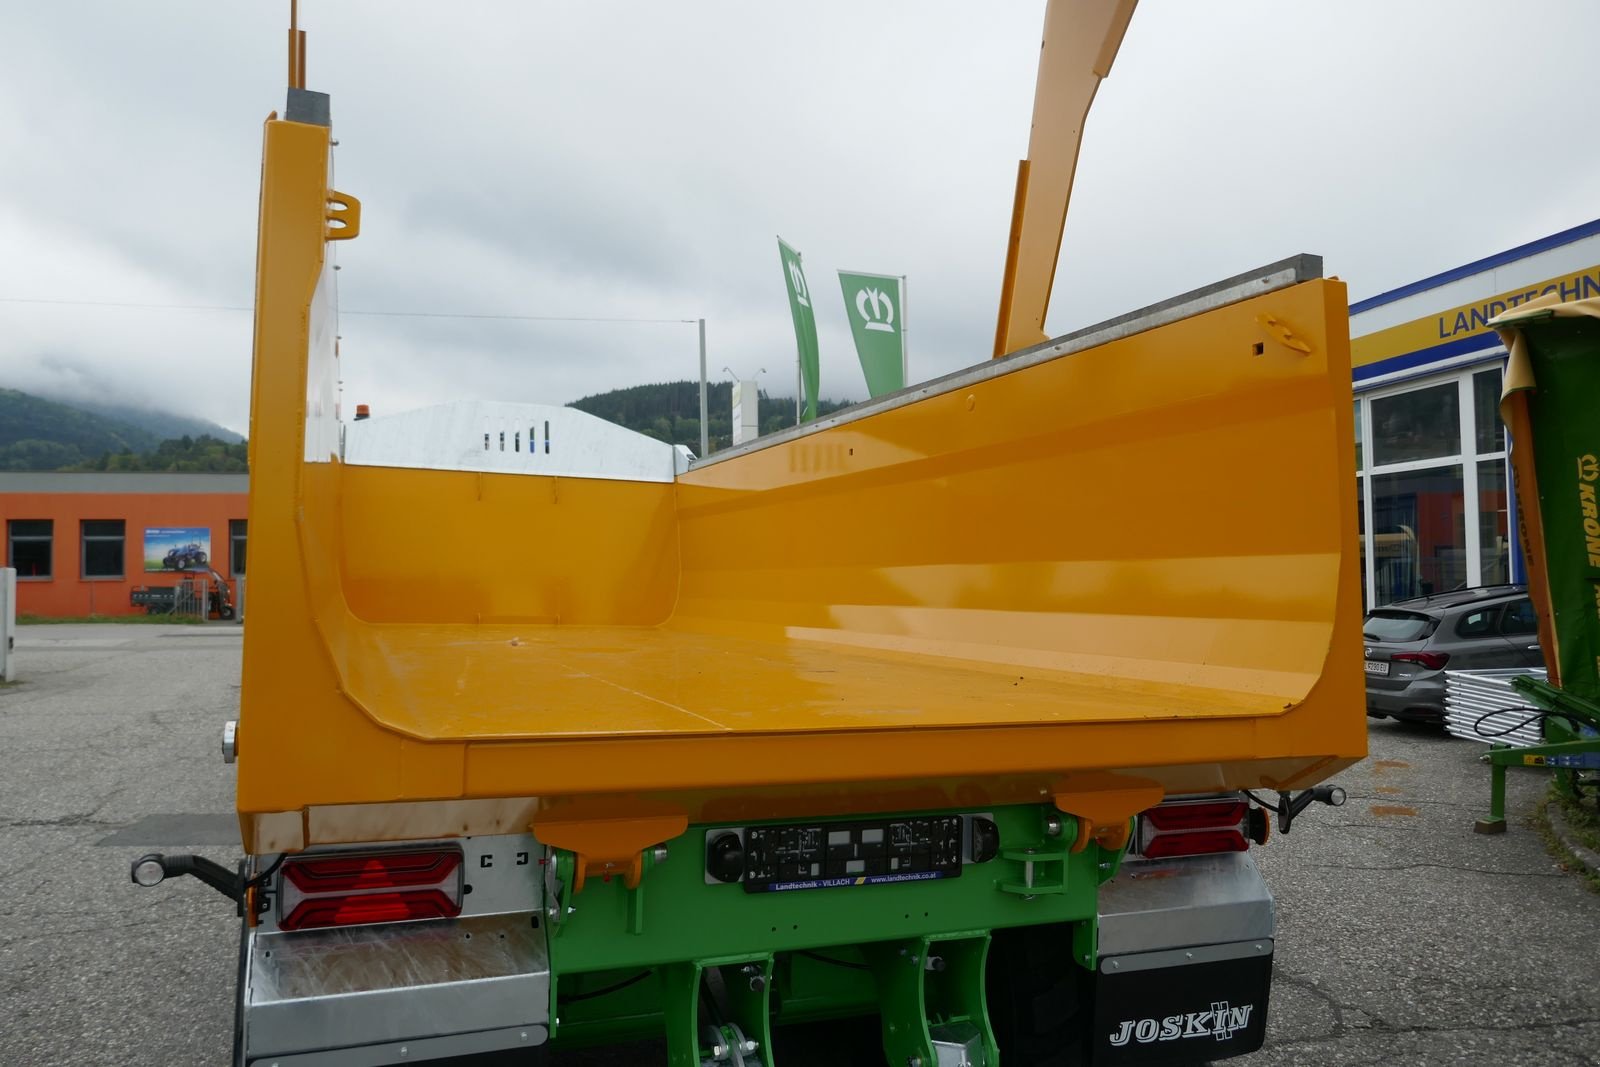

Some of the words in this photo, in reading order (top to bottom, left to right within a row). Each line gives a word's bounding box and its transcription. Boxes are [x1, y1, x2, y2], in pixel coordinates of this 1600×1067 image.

[1579, 482, 1600, 568] KRONE
[775, 881, 818, 891] Landtechnik
[822, 878, 850, 887] VILLACH
[870, 871, 937, 884] www.landtechnik.co.at
[1109, 1002, 1253, 1047] JOSKIN
